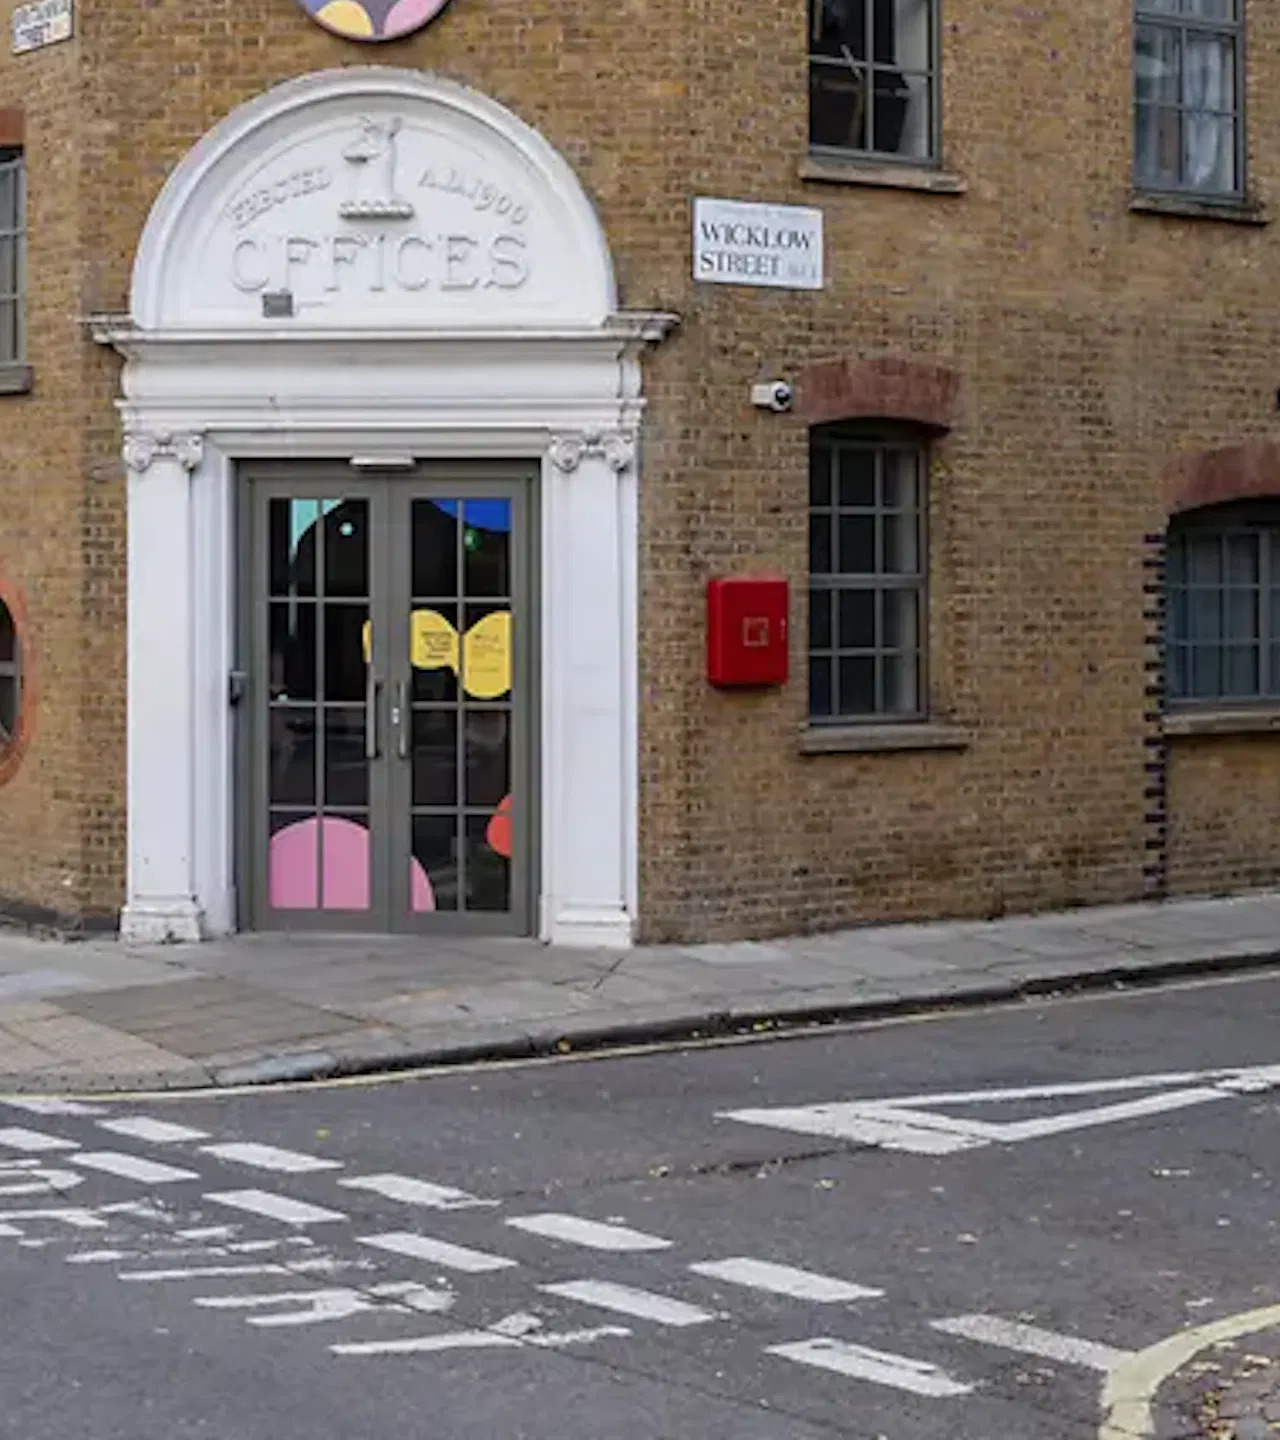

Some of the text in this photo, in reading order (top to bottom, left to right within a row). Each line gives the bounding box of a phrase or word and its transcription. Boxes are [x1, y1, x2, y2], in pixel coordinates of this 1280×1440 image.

[700, 220, 814, 251] WICKLOW
[230, 232, 530, 292] OFFICES
[700, 250, 780, 277] STREET
